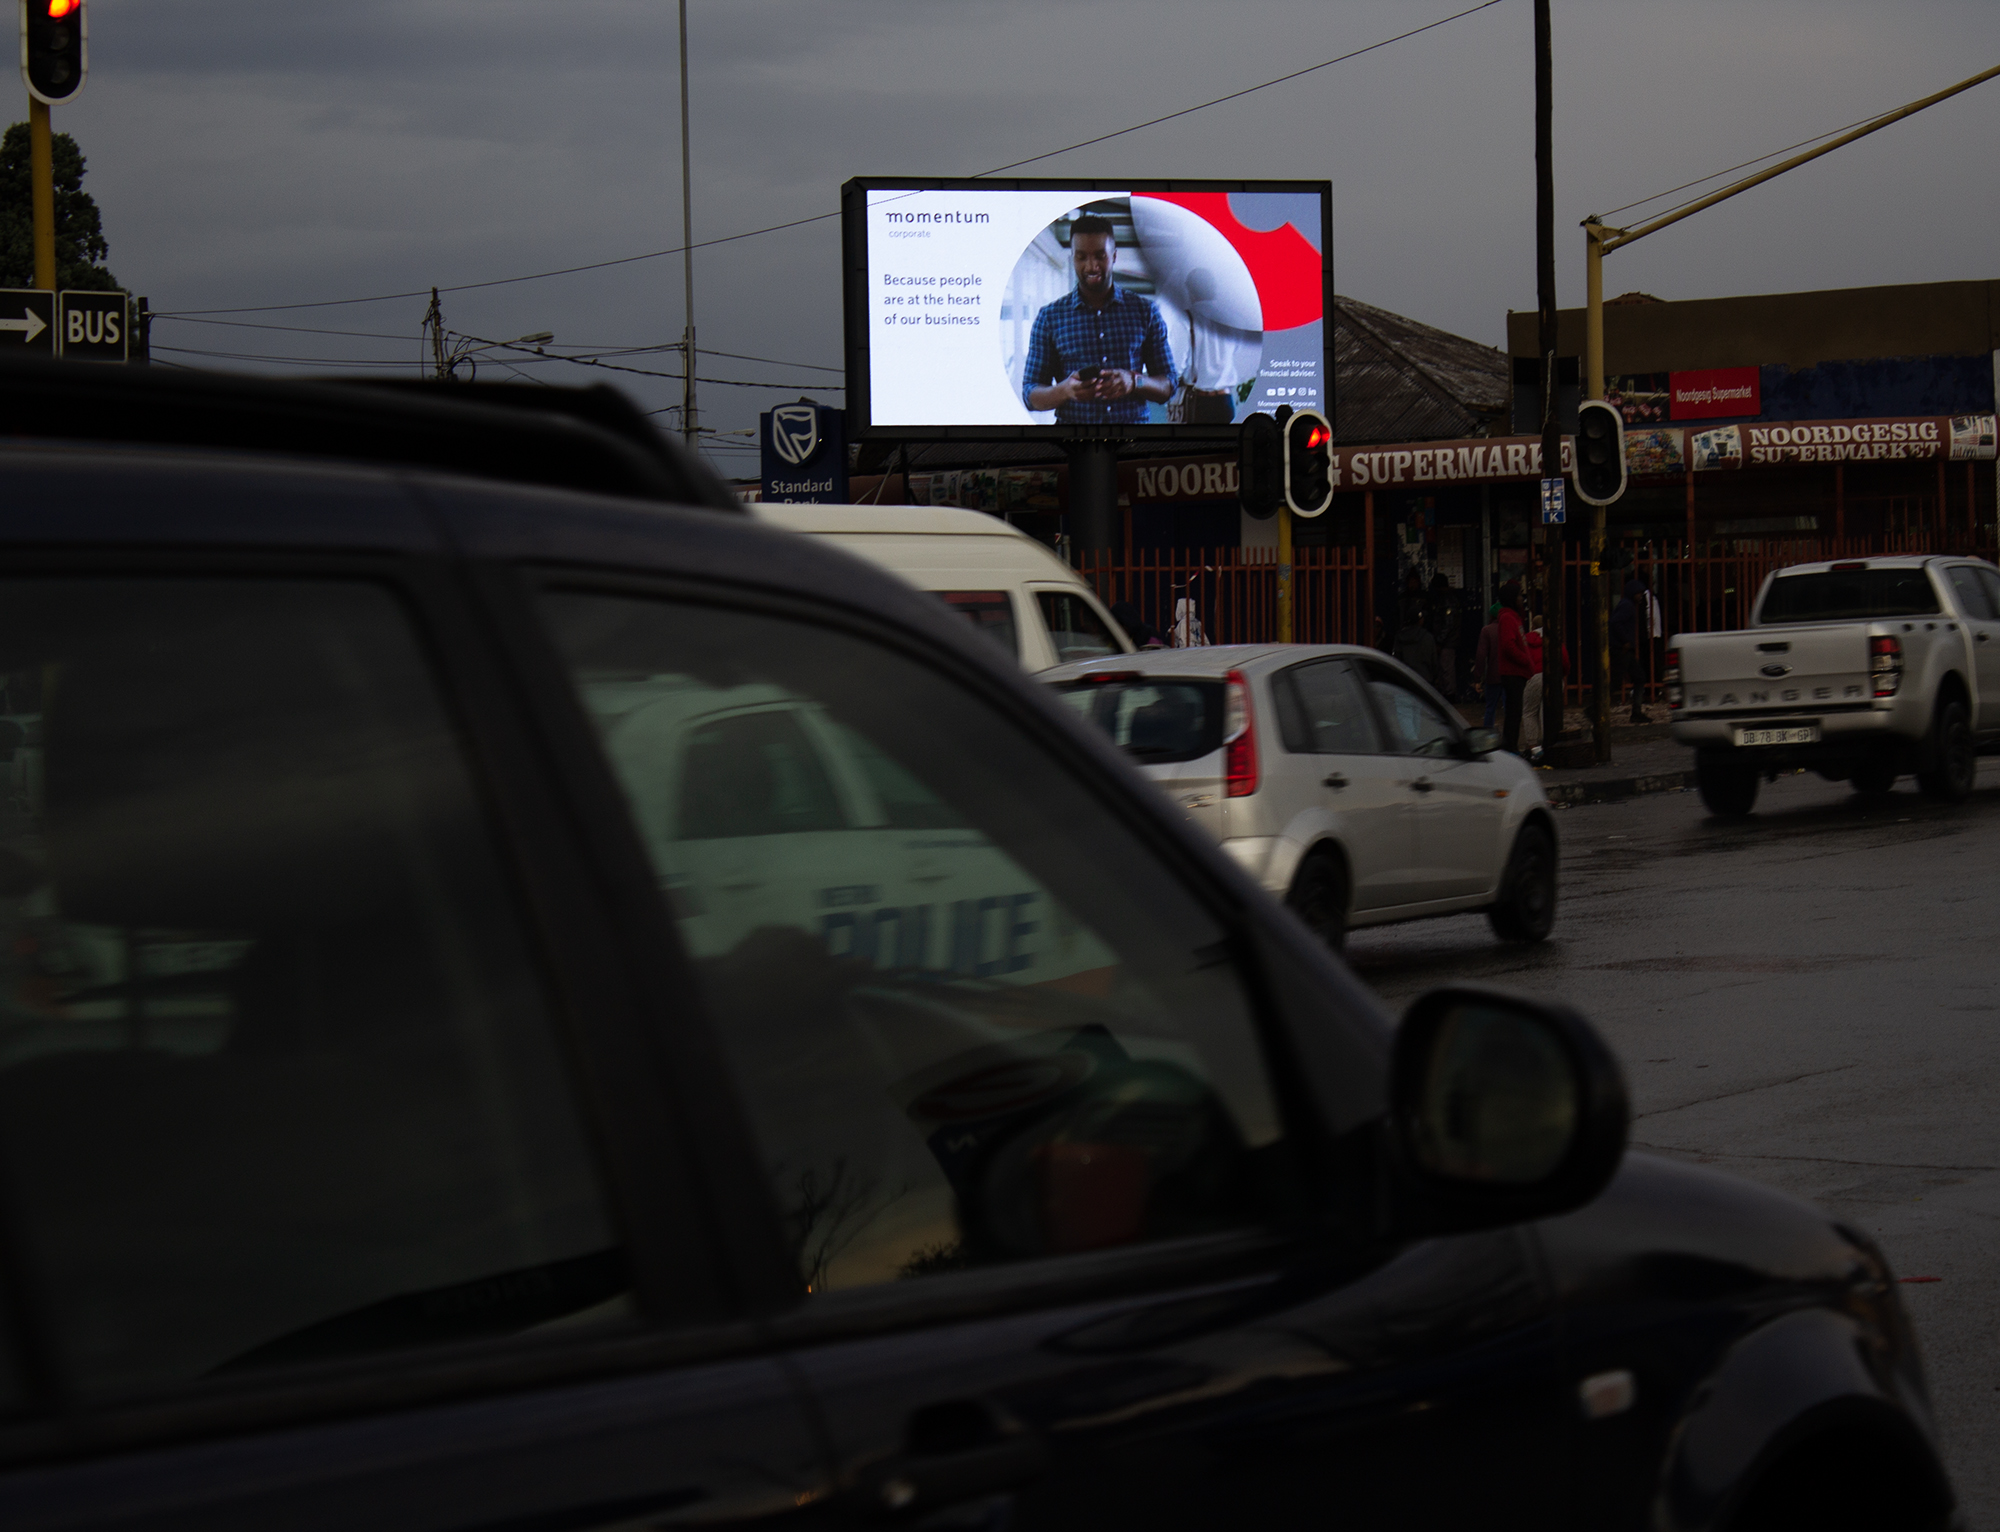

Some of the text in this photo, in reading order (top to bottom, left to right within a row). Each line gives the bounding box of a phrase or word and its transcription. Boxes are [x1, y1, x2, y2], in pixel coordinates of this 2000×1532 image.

[885, 211, 990, 223] momentum
[888, 230, 931, 239] corporate
[884, 274, 982, 288] Because people
[884, 293, 981, 305] are at the heart
[67, 309, 120, 344] BUS
[884, 313, 980, 325] of our business
[1270, 360, 1291, 368] Speak
[1676, 385, 1753, 405] Noordgesig Supermarket
[1749, 422, 1939, 446] NOORDGESIG
[1750, 441, 1941, 464] SUPERMARKET
[1351, 441, 1573, 486] SUPERMARKE
[770, 478, 833, 494] Standard
[1550, 512, 1560, 523] K
[1691, 684, 1863, 707] RANGER
